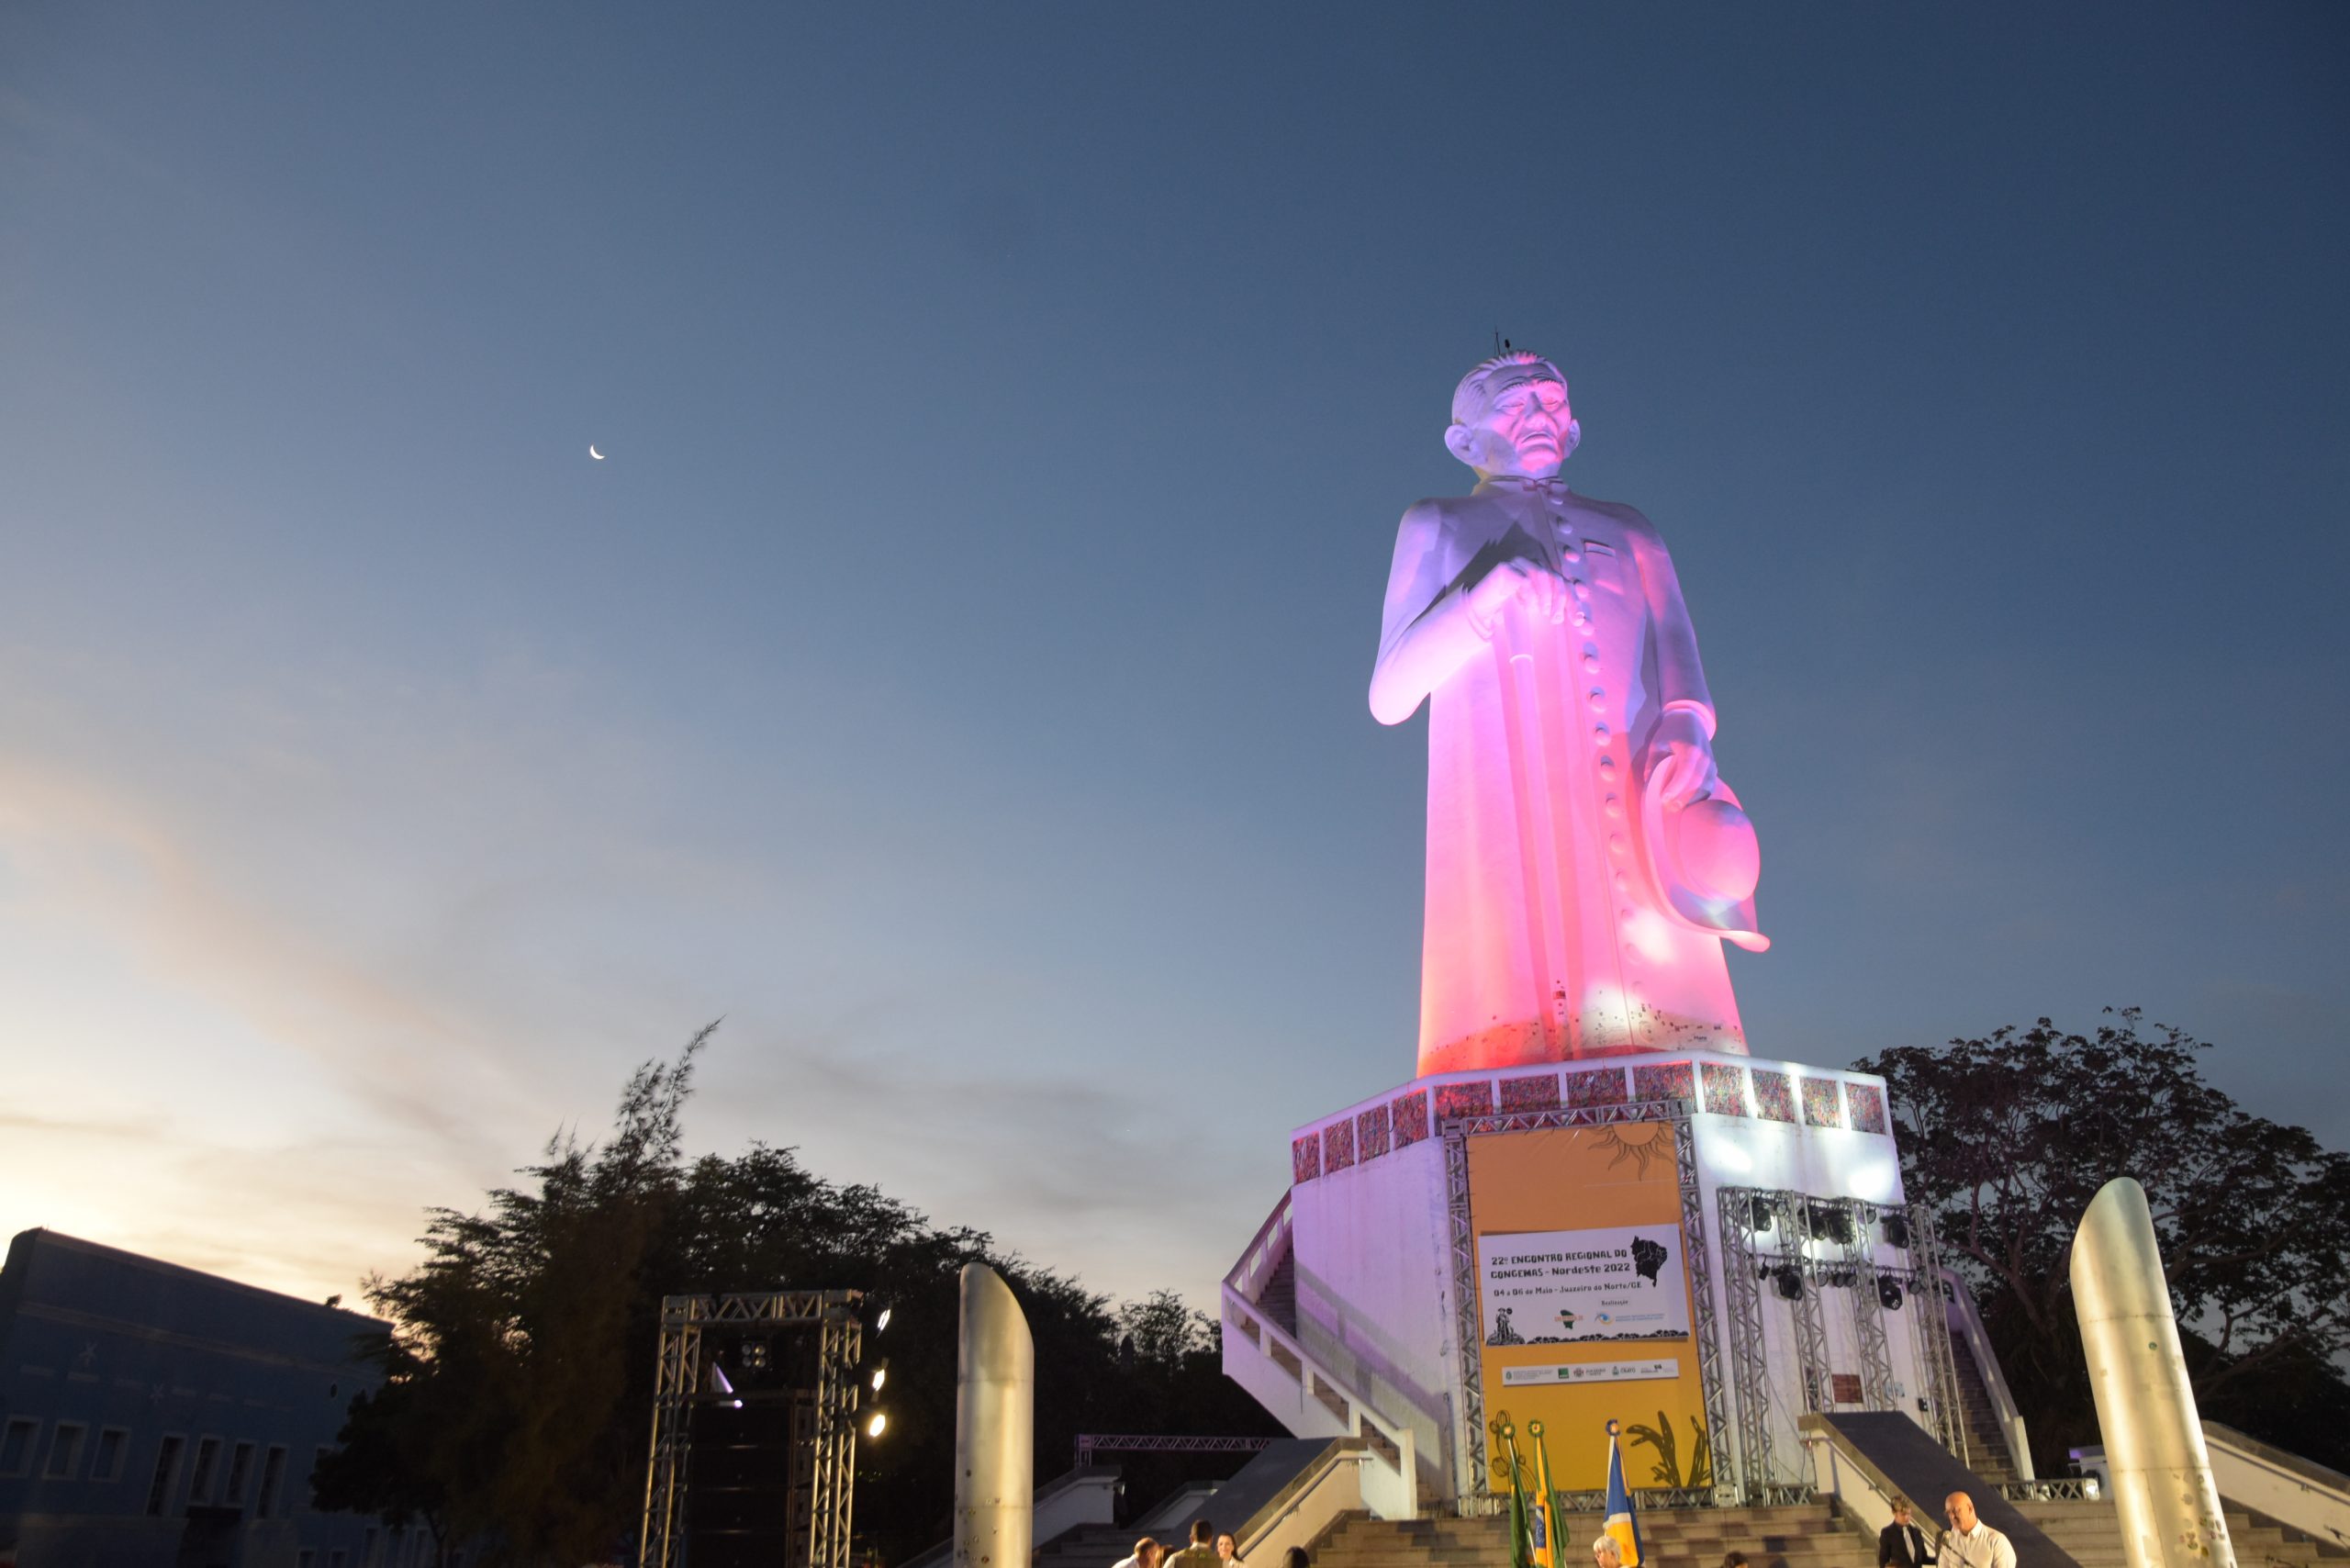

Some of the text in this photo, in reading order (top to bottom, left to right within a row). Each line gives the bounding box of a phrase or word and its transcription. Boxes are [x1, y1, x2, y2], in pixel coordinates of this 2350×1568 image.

[1511, 1253, 1562, 1264] ENCONTRO
[1565, 1250, 1612, 1261] REGIONAL
[1615, 1249, 1628, 1258] DO
[1491, 1268, 1543, 1279] CONGEMAS
[1552, 1265, 1601, 1275] Nordeste
[1604, 1262, 1630, 1272] 2022
[1512, 1288, 1524, 1296] 06
[1535, 1286, 1553, 1294] Maio
[1560, 1284, 1592, 1294] Juazeiro
[1604, 1281, 1642, 1291] Norte/CE
